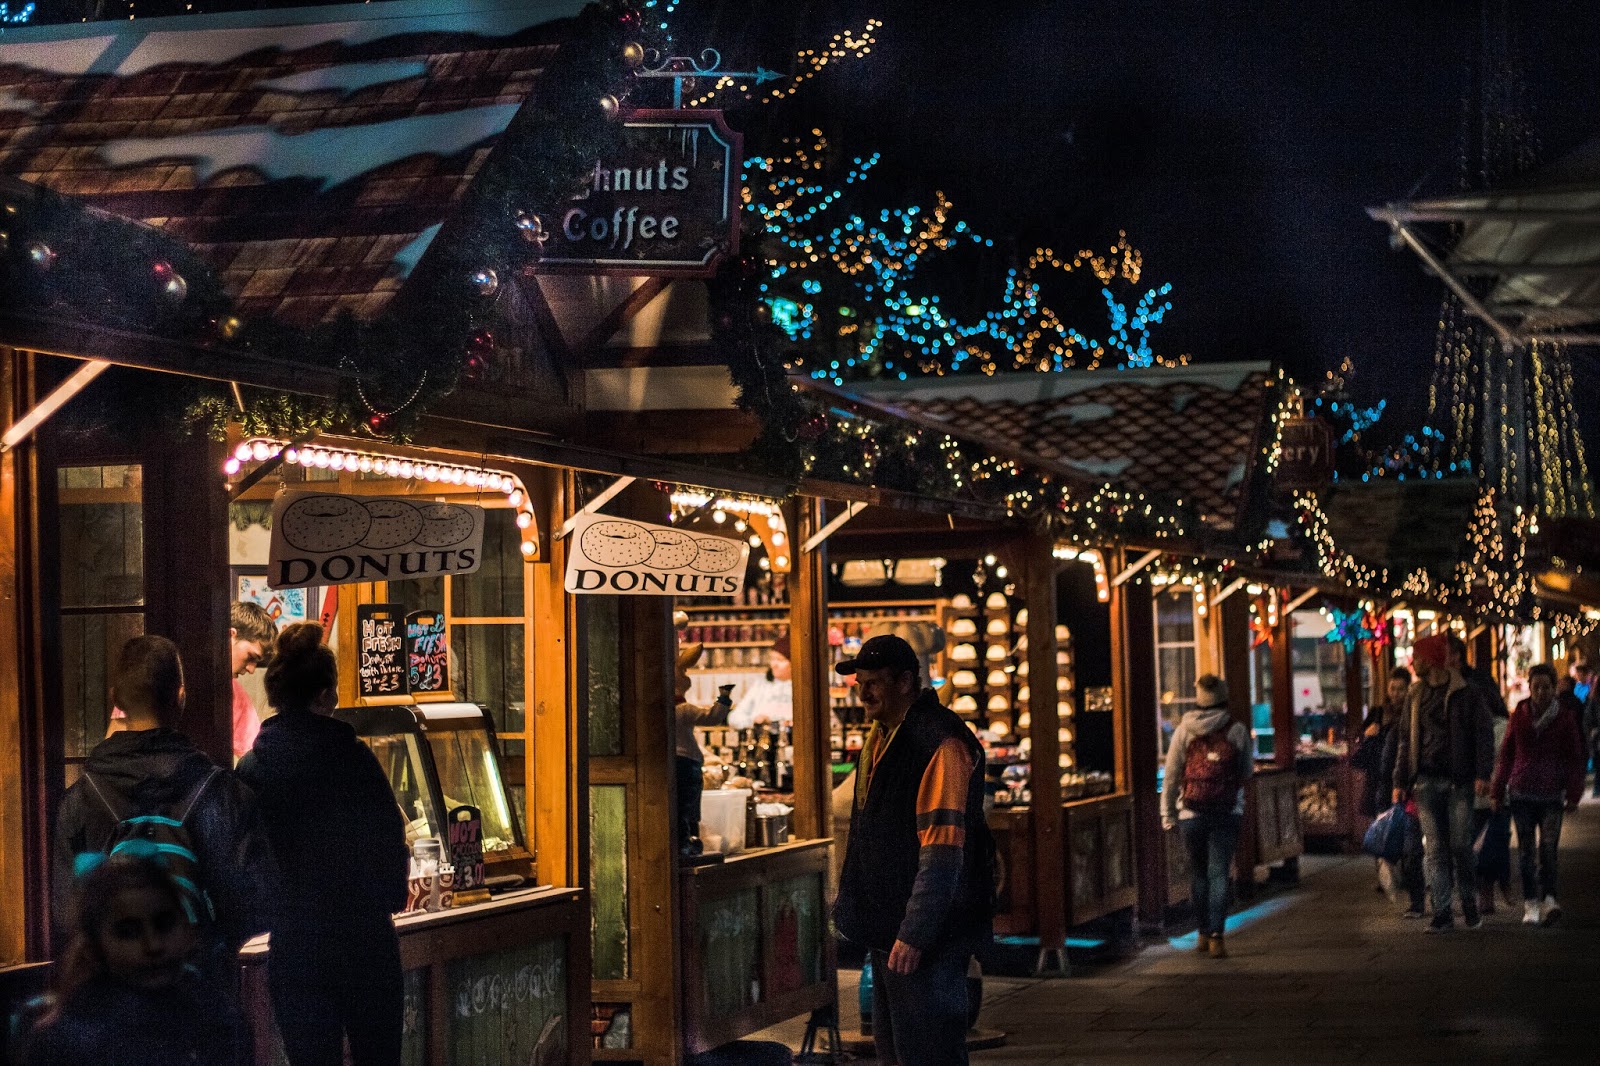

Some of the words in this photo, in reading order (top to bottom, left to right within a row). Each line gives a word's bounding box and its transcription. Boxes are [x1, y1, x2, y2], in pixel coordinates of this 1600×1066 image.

[573, 158, 690, 200] hnuts
[562, 206, 680, 250] Coffee
[1282, 446, 1320, 466] ery
[275, 547, 477, 587] DONUTS
[572, 568, 739, 594] DONUTS
[363, 677, 373, 692] 3
